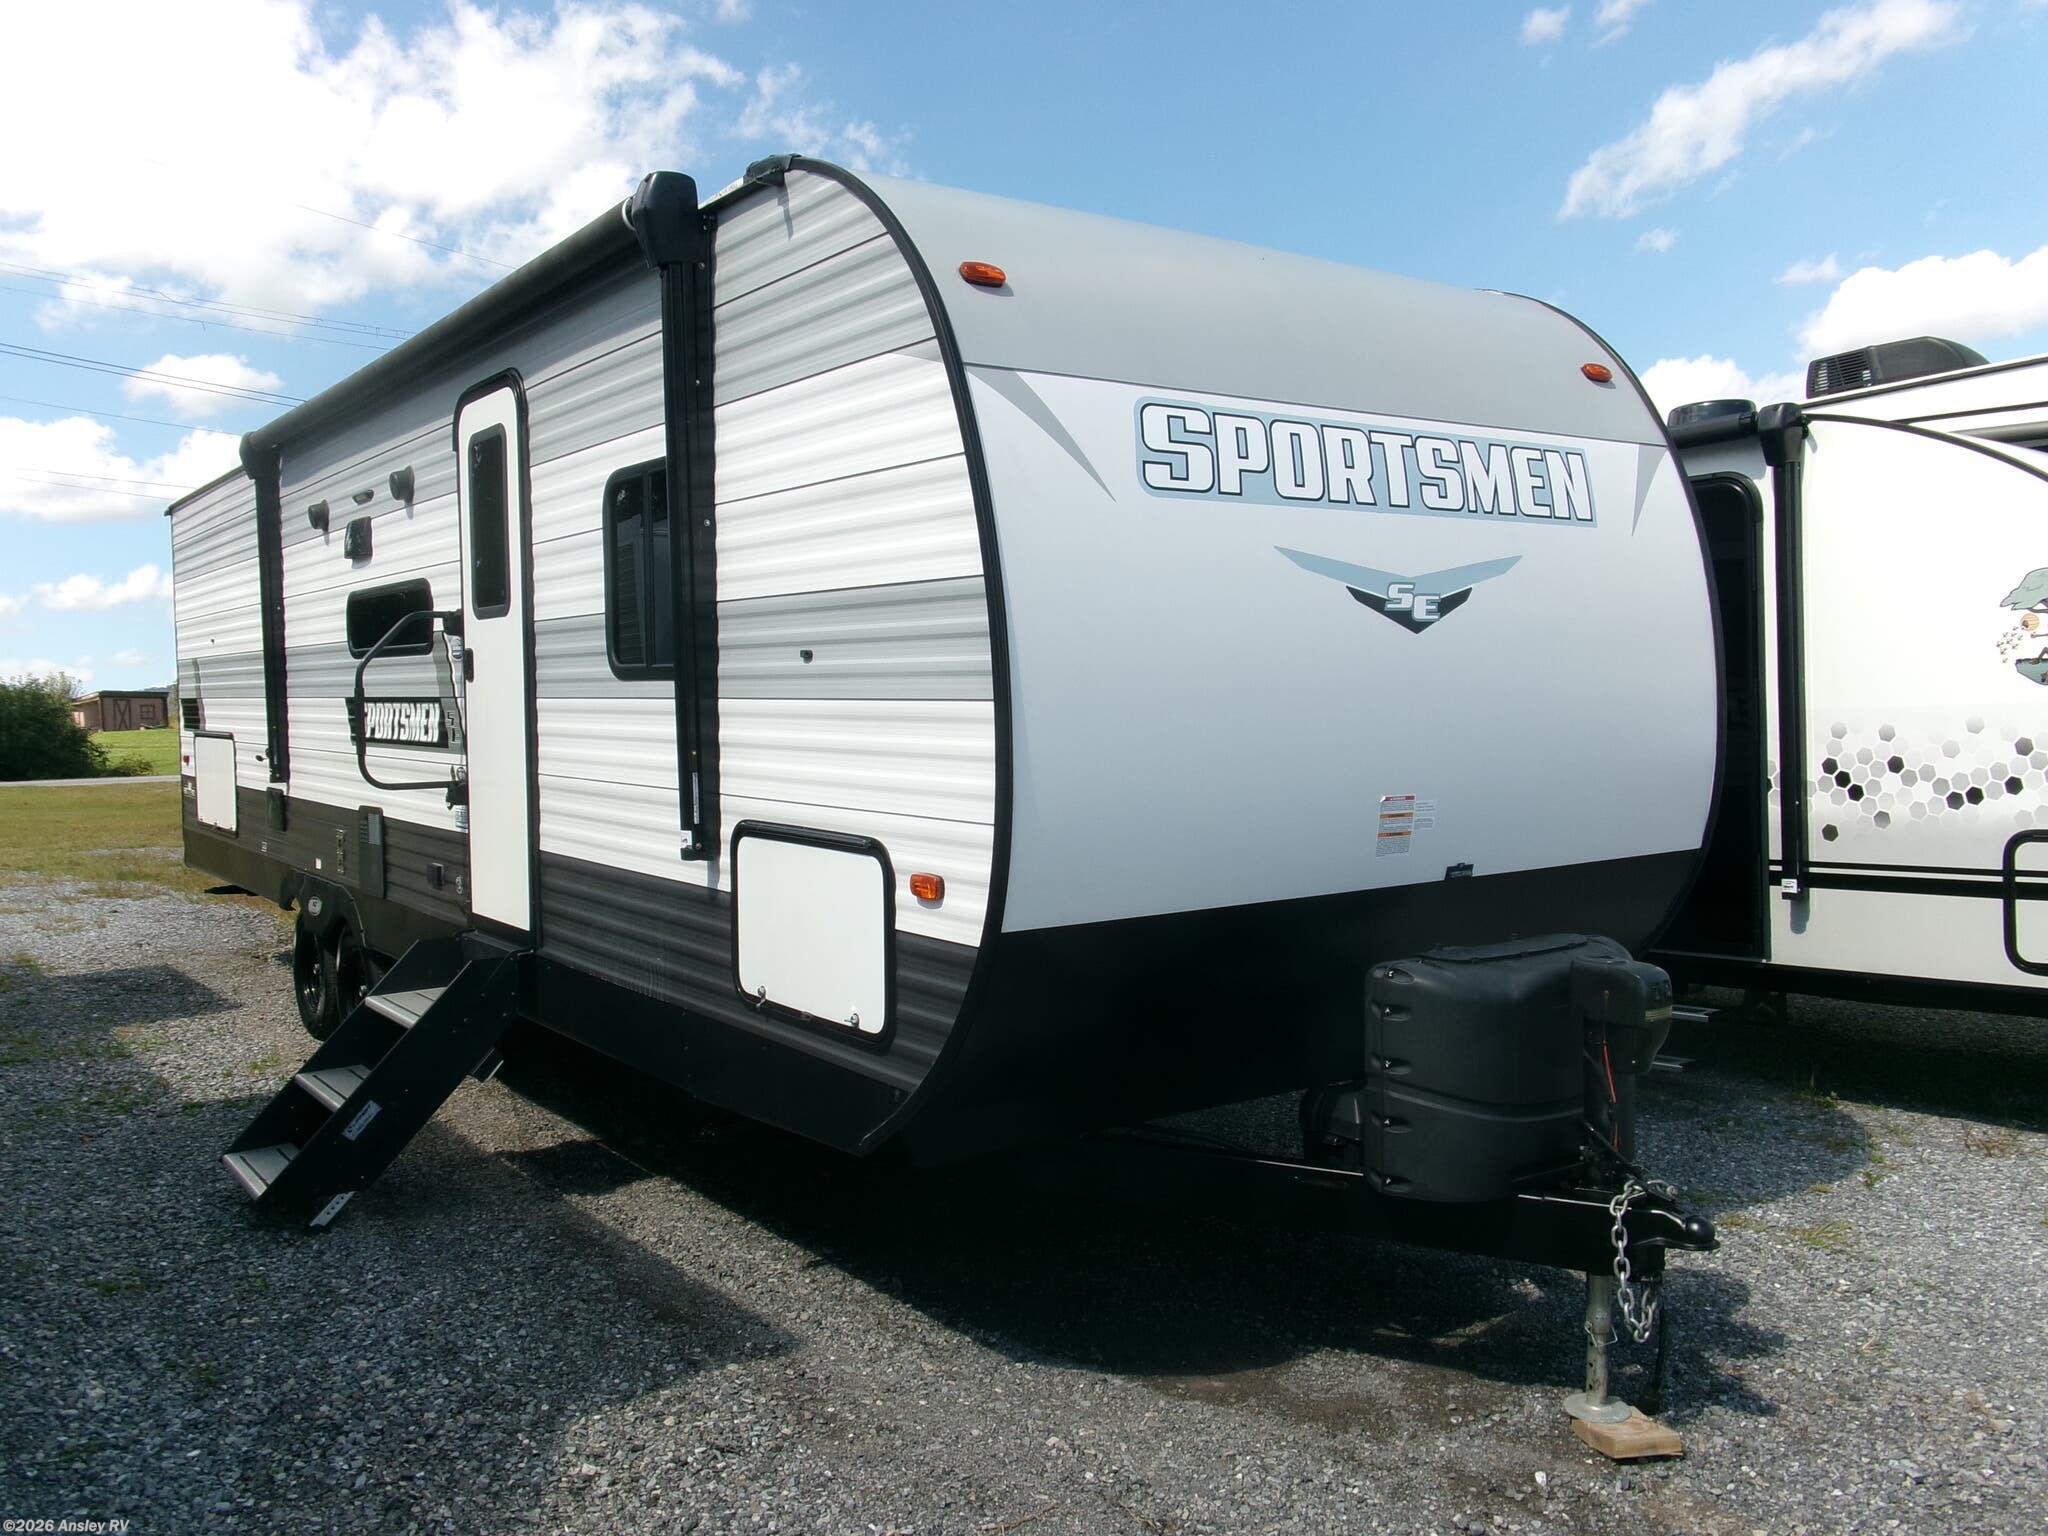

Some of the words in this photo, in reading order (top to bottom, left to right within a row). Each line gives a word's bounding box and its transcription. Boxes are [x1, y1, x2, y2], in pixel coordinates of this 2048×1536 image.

[1140, 402, 1594, 522] SPORTSMEN
[1385, 582, 1441, 622] SE
[364, 701, 441, 744] PORTSMEN
